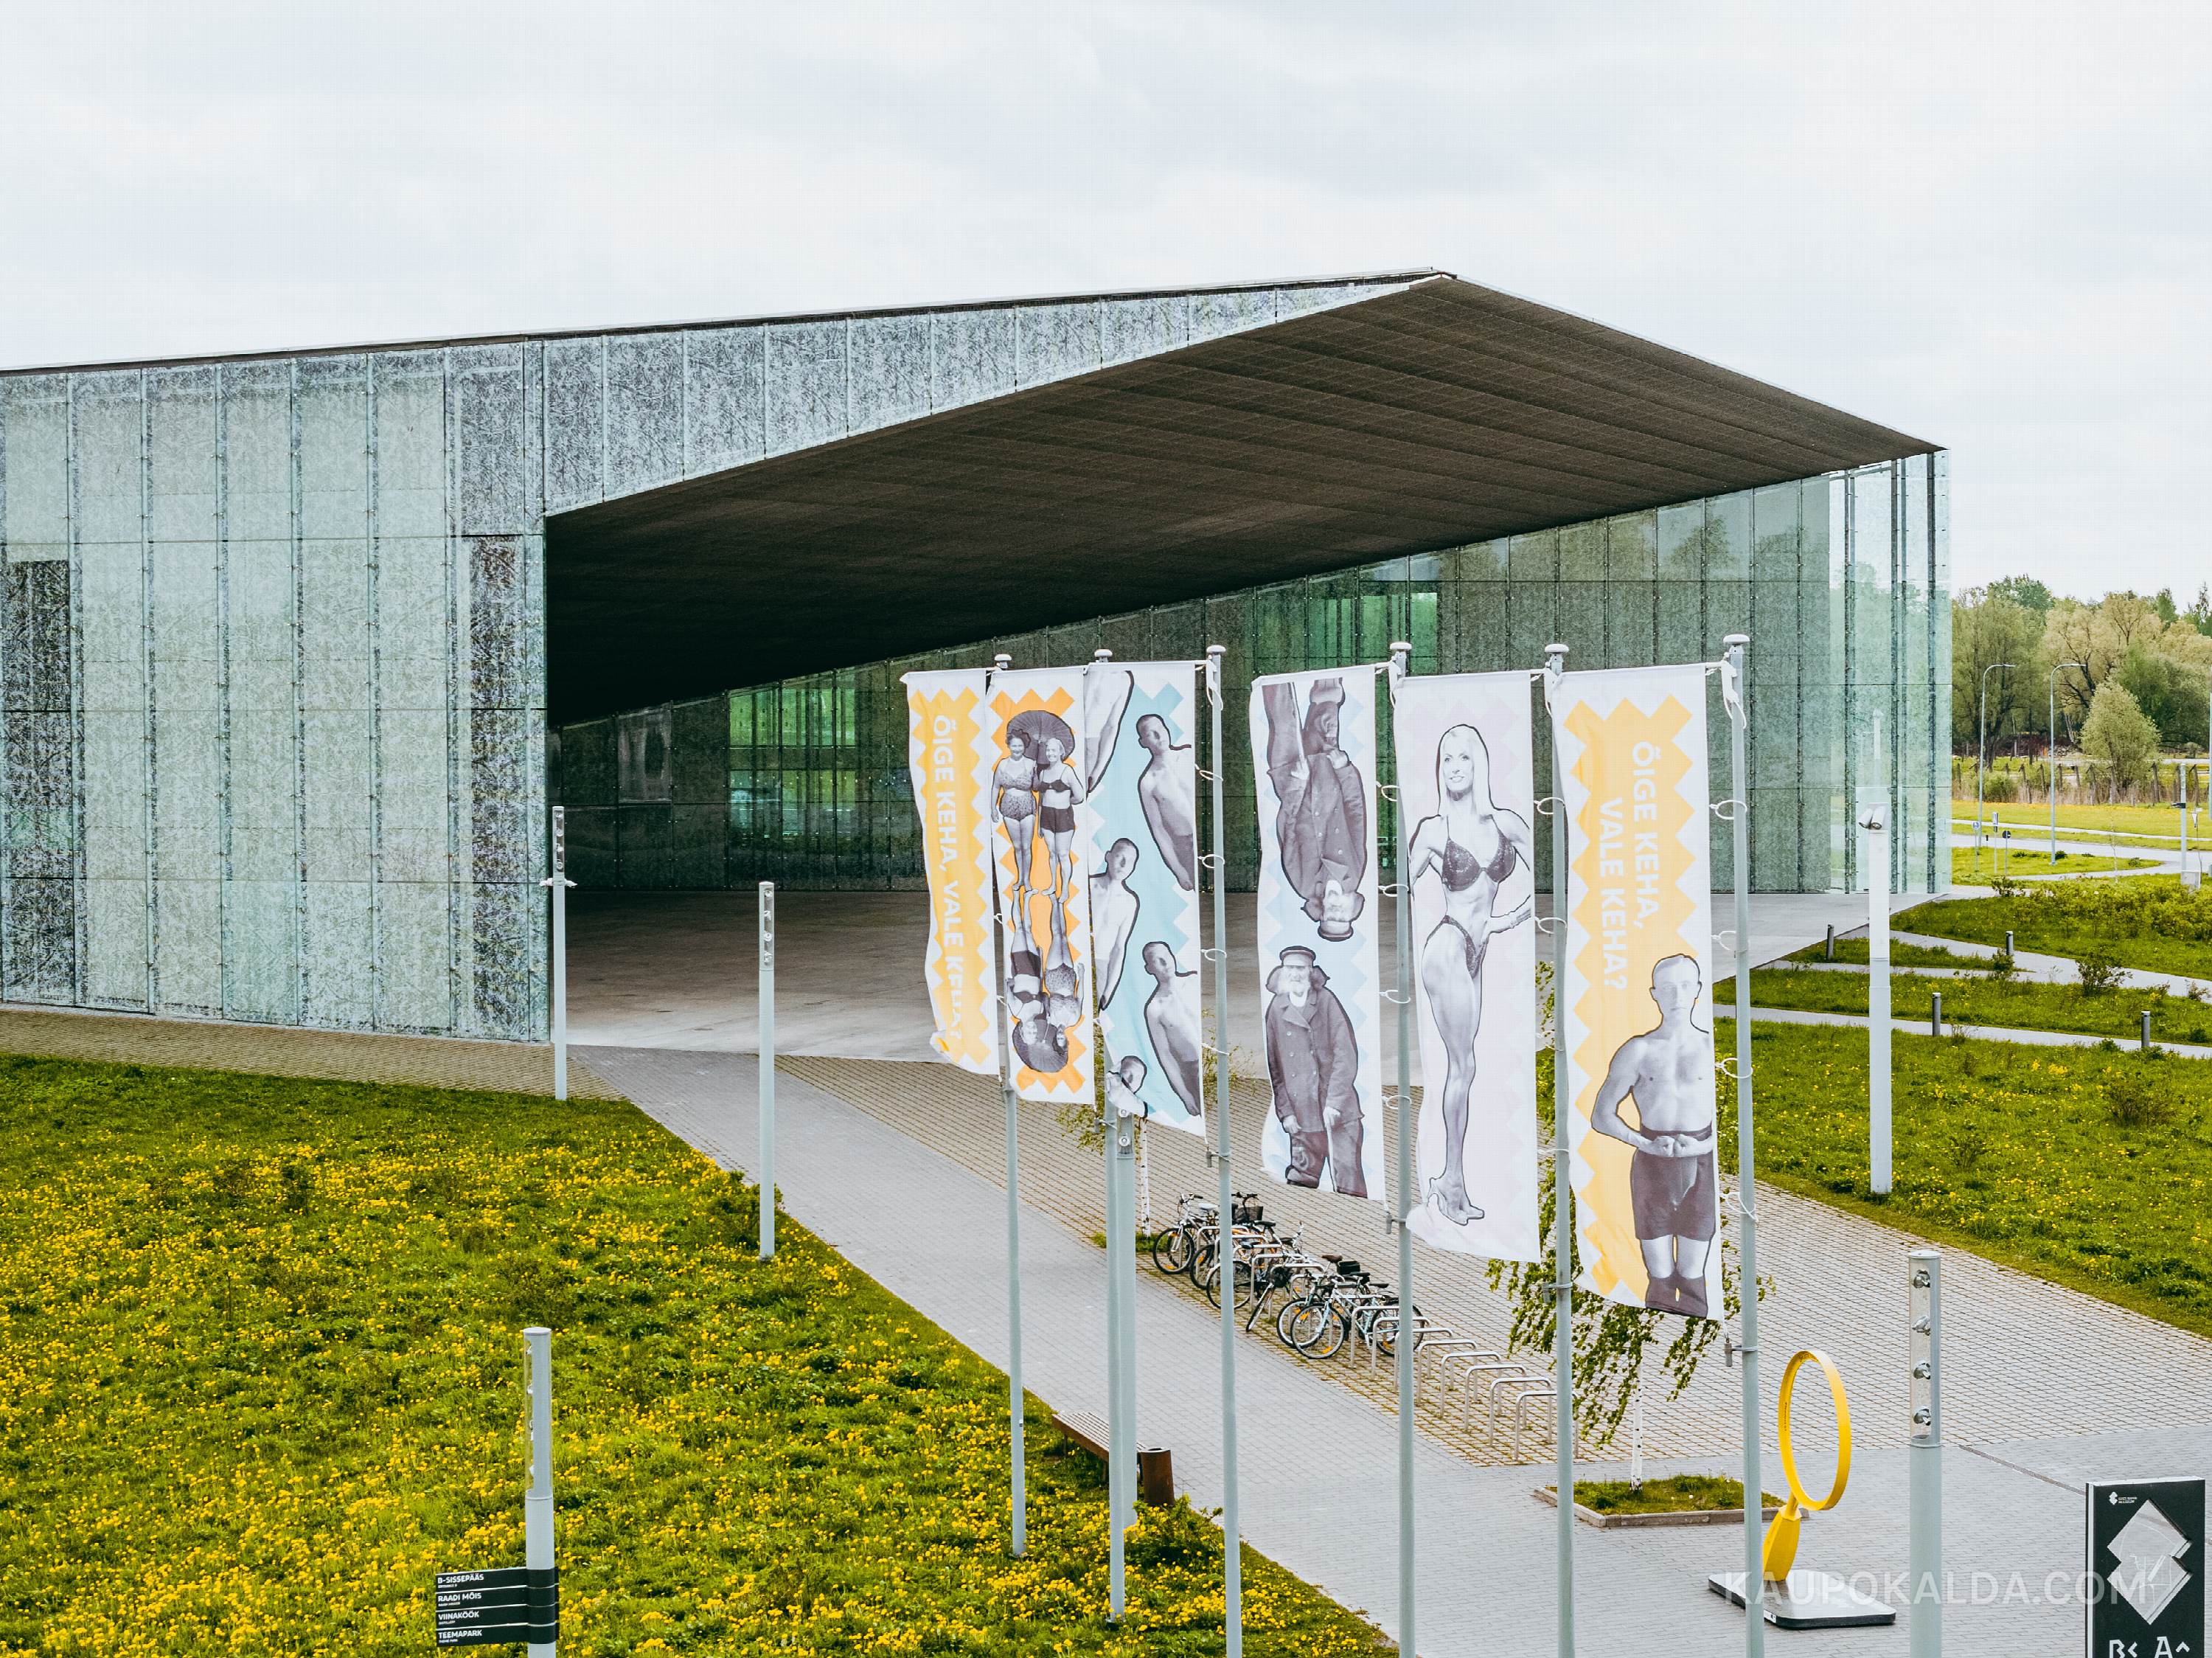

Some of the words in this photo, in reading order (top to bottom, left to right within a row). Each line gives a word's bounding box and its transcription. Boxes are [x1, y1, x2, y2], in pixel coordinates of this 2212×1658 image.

[933, 715, 956, 783] ÕIGE
[1632, 740, 1661, 822] ÕIGE
[936, 793, 958, 872] KEHA,
[1599, 797, 1624, 878] VALE
[942, 881, 964, 948] VALE
[1633, 833, 1660, 929] KEHA,
[1601, 888, 1628, 990] KEHA?
[438, 1573, 484, 1584] B-SISSEPÄÄS
[438, 1611, 479, 1620] VIINAKÖÖK
[439, 1630, 482, 1639] TEEMAPARK
